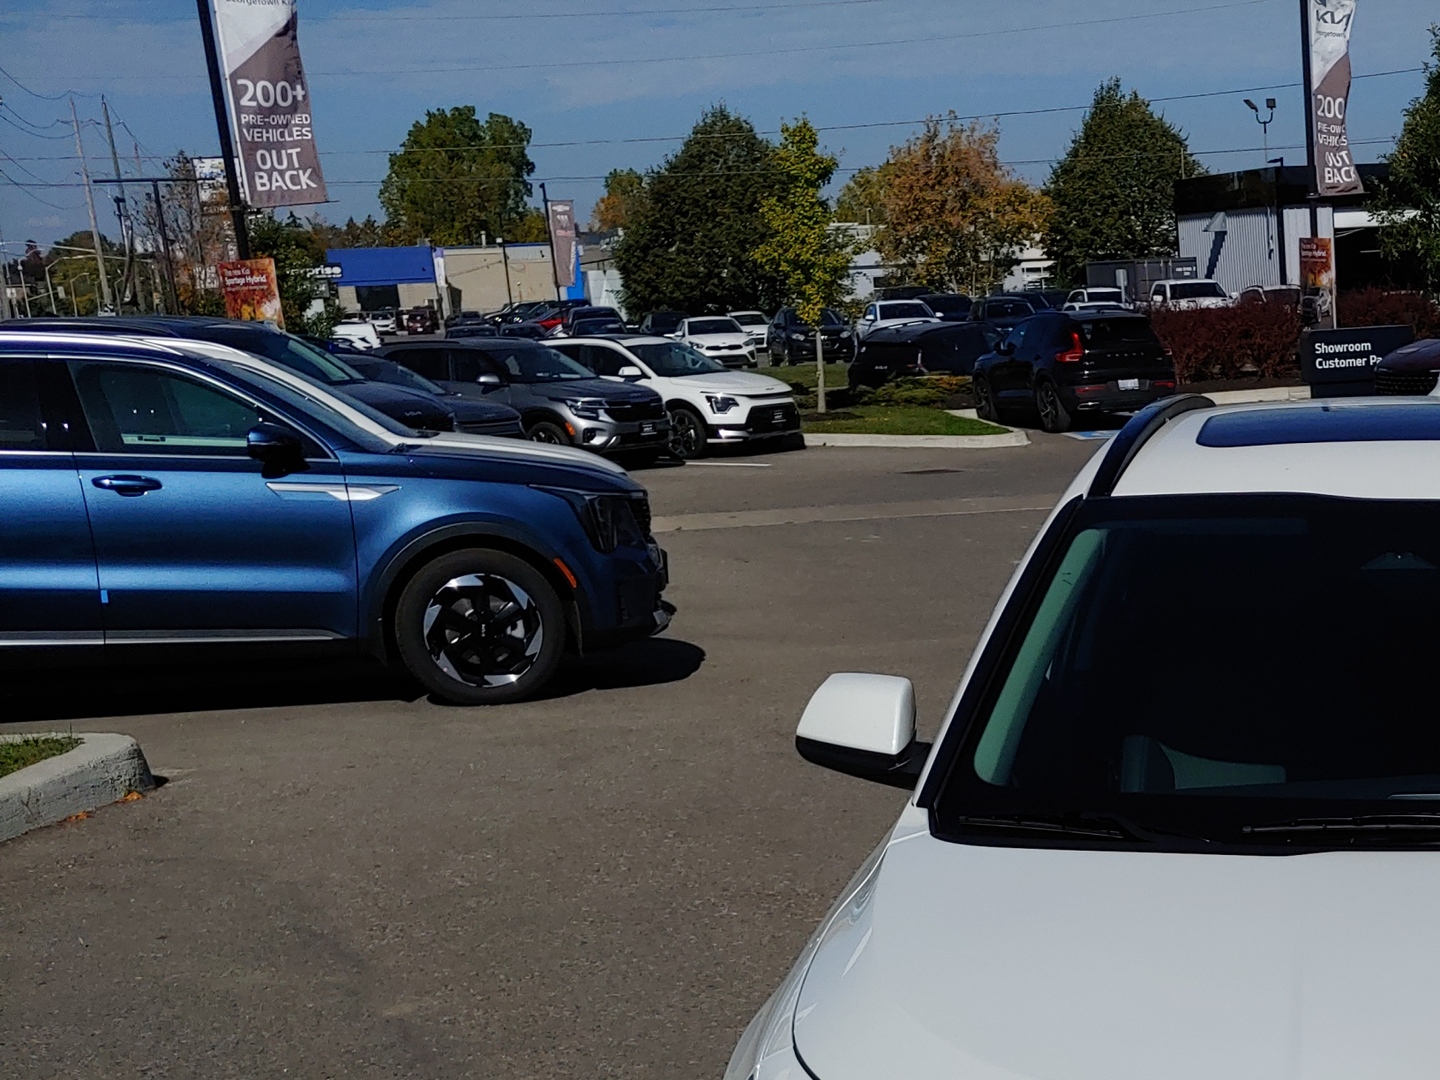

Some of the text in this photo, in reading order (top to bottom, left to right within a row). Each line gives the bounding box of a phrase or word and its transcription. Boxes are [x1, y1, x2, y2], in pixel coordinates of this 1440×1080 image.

[1316, 8, 1353, 32] KIA
[236, 79, 306, 108] 200+
[240, 113, 311, 125] PRE-OWNED
[242, 126, 312, 142] VEHICLES
[255, 148, 302, 170] OUT
[1325, 150, 1350, 167] OUT
[254, 168, 318, 191] BACK
[1315, 342, 1372, 354] Showroom
[1315, 357, 1367, 369] Customer
